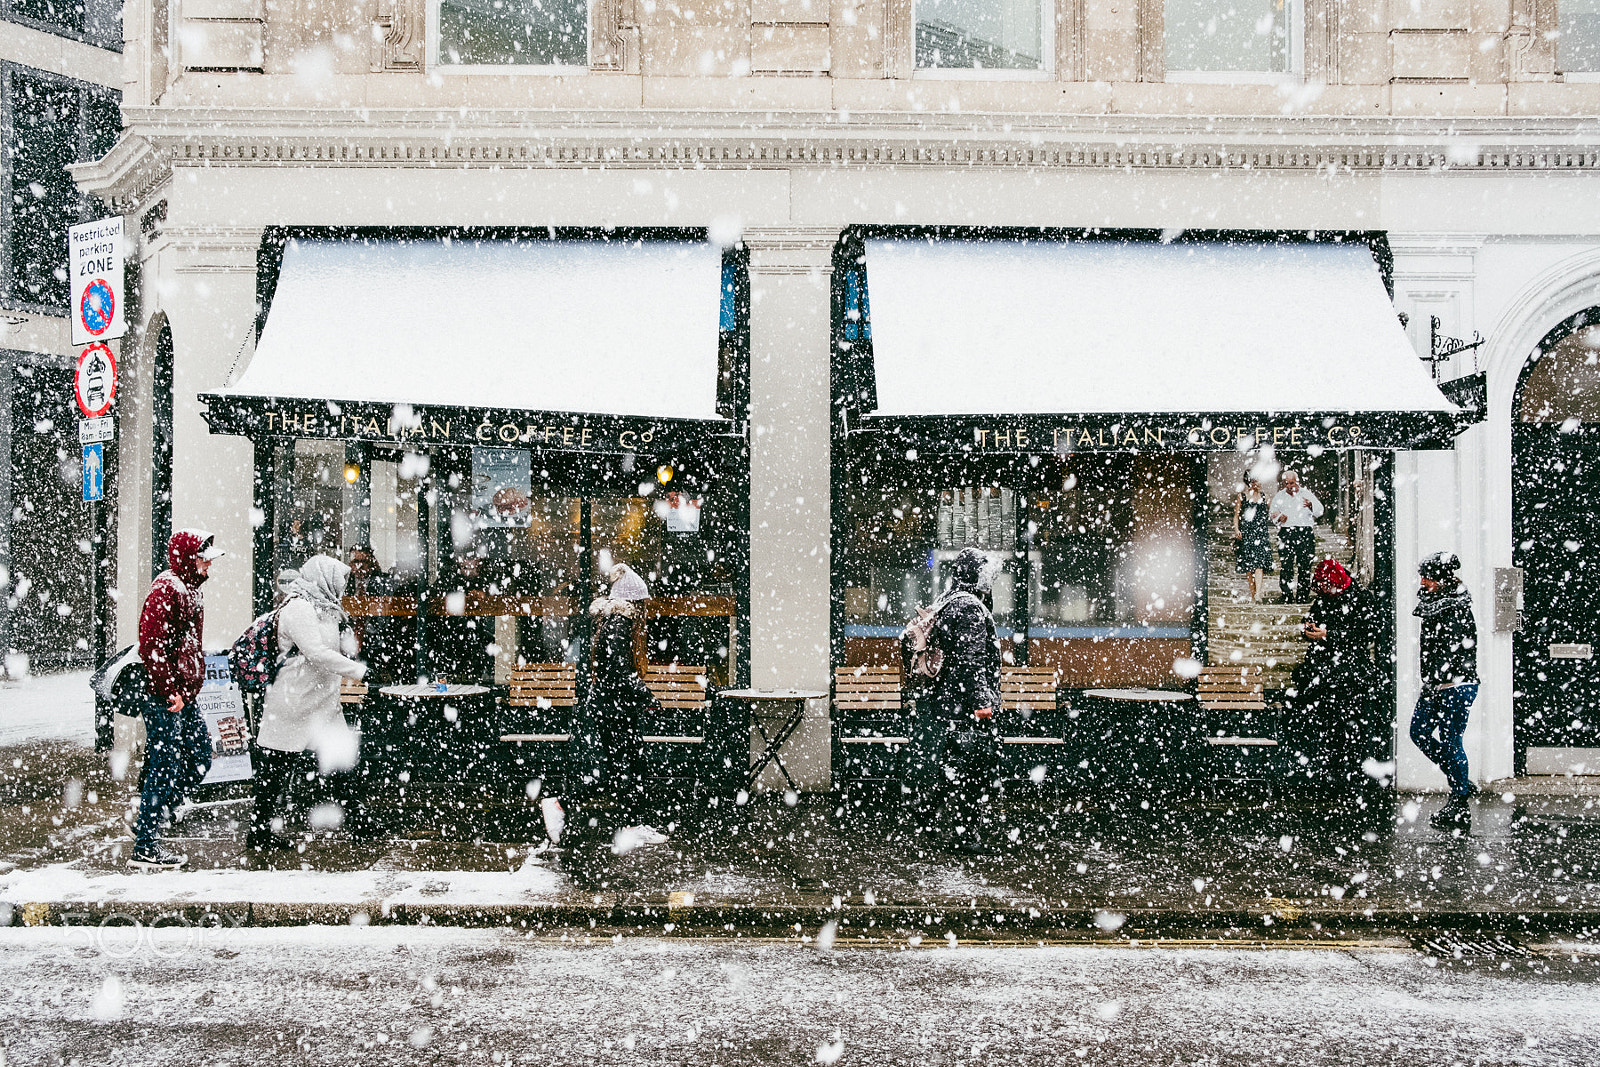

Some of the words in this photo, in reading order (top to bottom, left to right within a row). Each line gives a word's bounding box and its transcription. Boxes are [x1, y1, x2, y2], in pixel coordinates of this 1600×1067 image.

[73, 223, 119, 242] Restricted
[80, 242, 113, 258] parking
[80, 257, 113, 276] ZONE
[265, 412, 315, 432] THE
[340, 416, 450, 437] ITALIAN
[476, 423, 592, 446] COFFEE
[979, 427, 1027, 447] THE
[1053, 427, 1162, 447] ITALIAN
[1189, 426, 1301, 445] COFFEE
